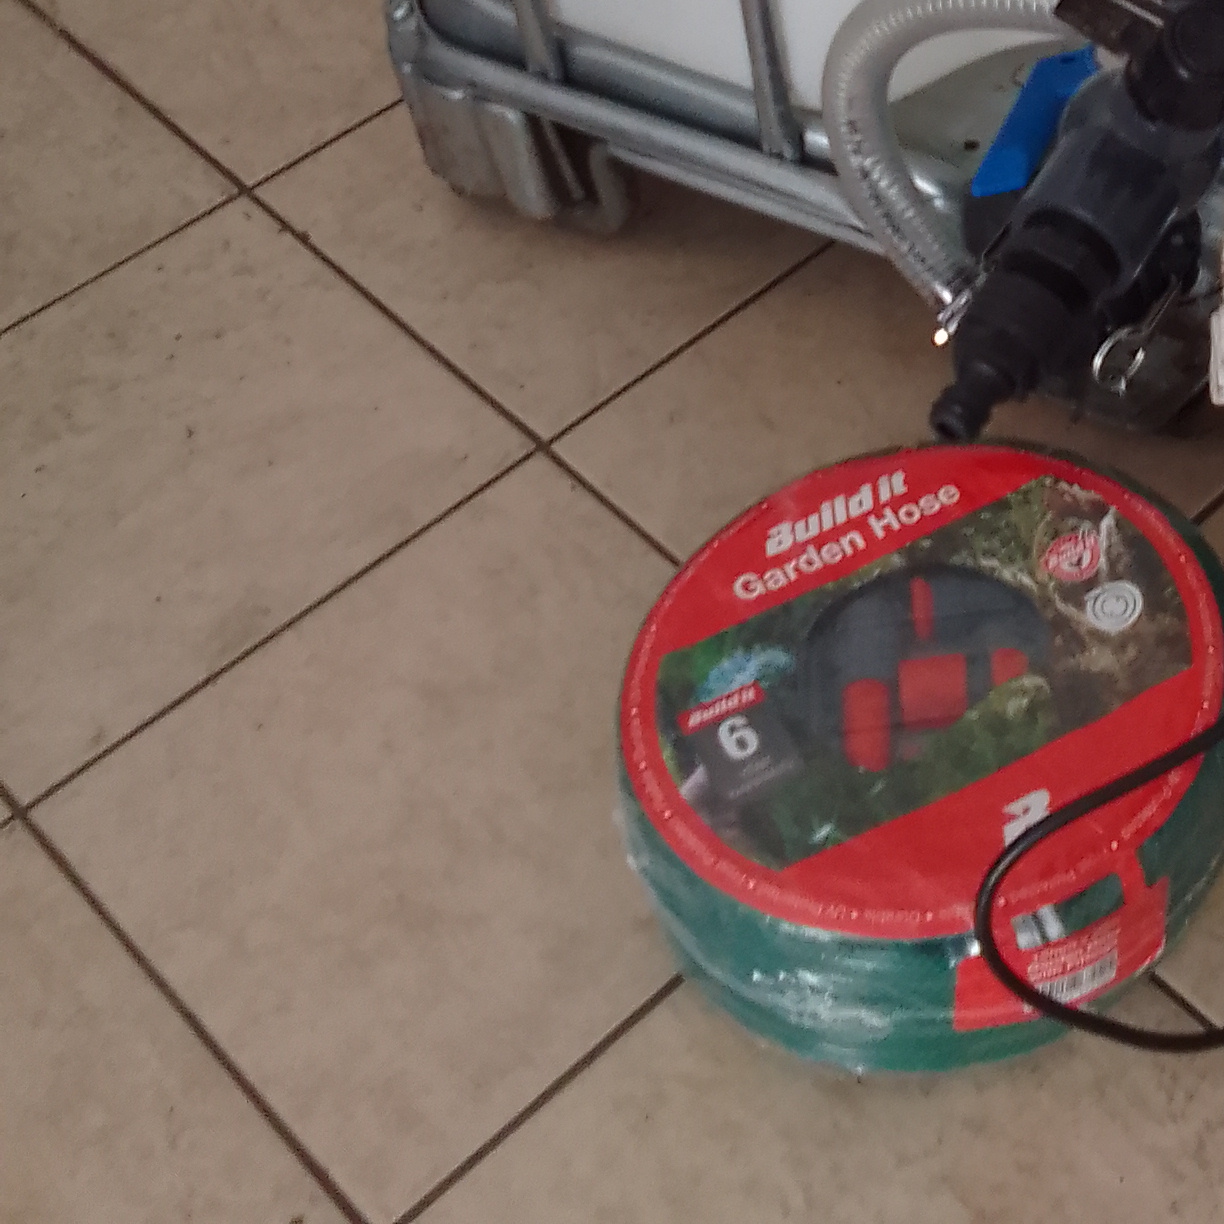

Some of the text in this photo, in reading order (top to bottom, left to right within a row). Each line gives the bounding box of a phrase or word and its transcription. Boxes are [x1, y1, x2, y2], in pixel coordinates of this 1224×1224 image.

[732, 484, 961, 601] Garden Hose
[765, 482, 874, 558] Build
[718, 714, 760, 761] 6
